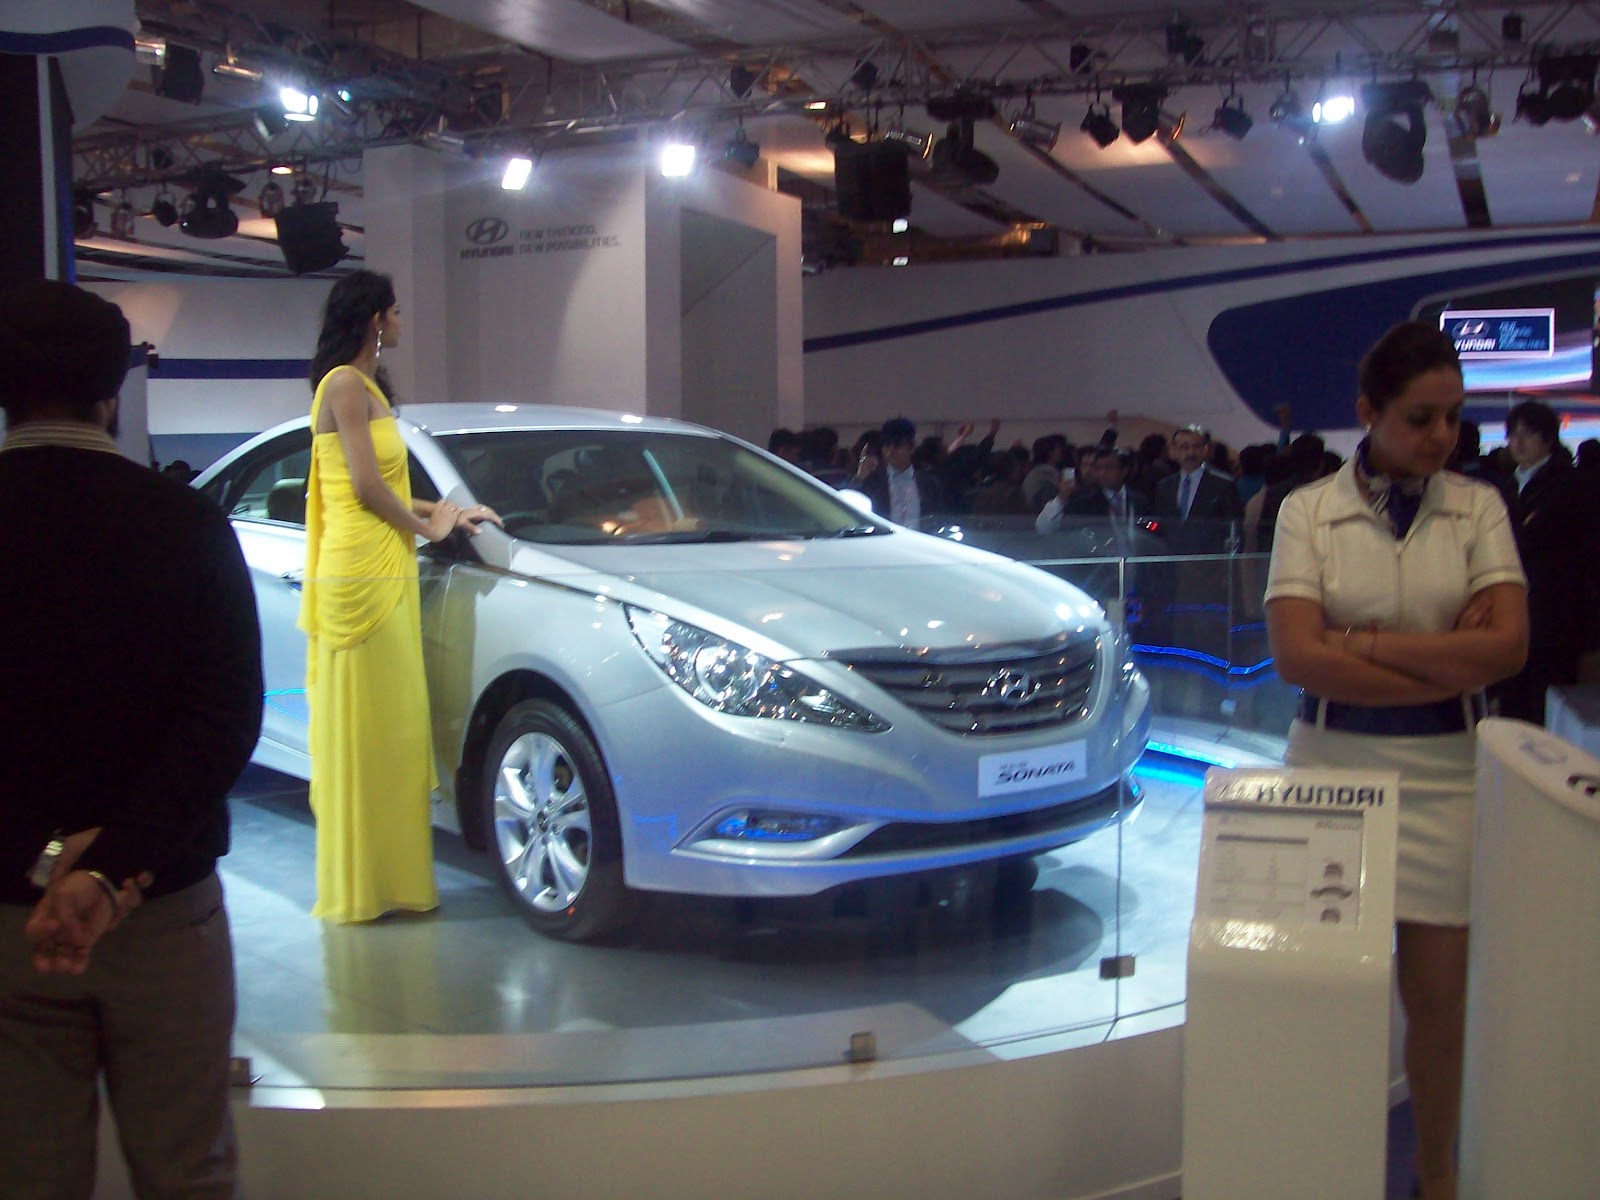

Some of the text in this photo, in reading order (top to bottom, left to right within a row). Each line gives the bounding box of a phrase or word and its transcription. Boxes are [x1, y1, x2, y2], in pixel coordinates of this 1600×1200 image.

[460, 246, 514, 259] HYUNDAI
[1453, 338, 1497, 351] YUNDAI
[994, 760, 1076, 785] SONATA
[1257, 784, 1385, 807] HYUNDAI
